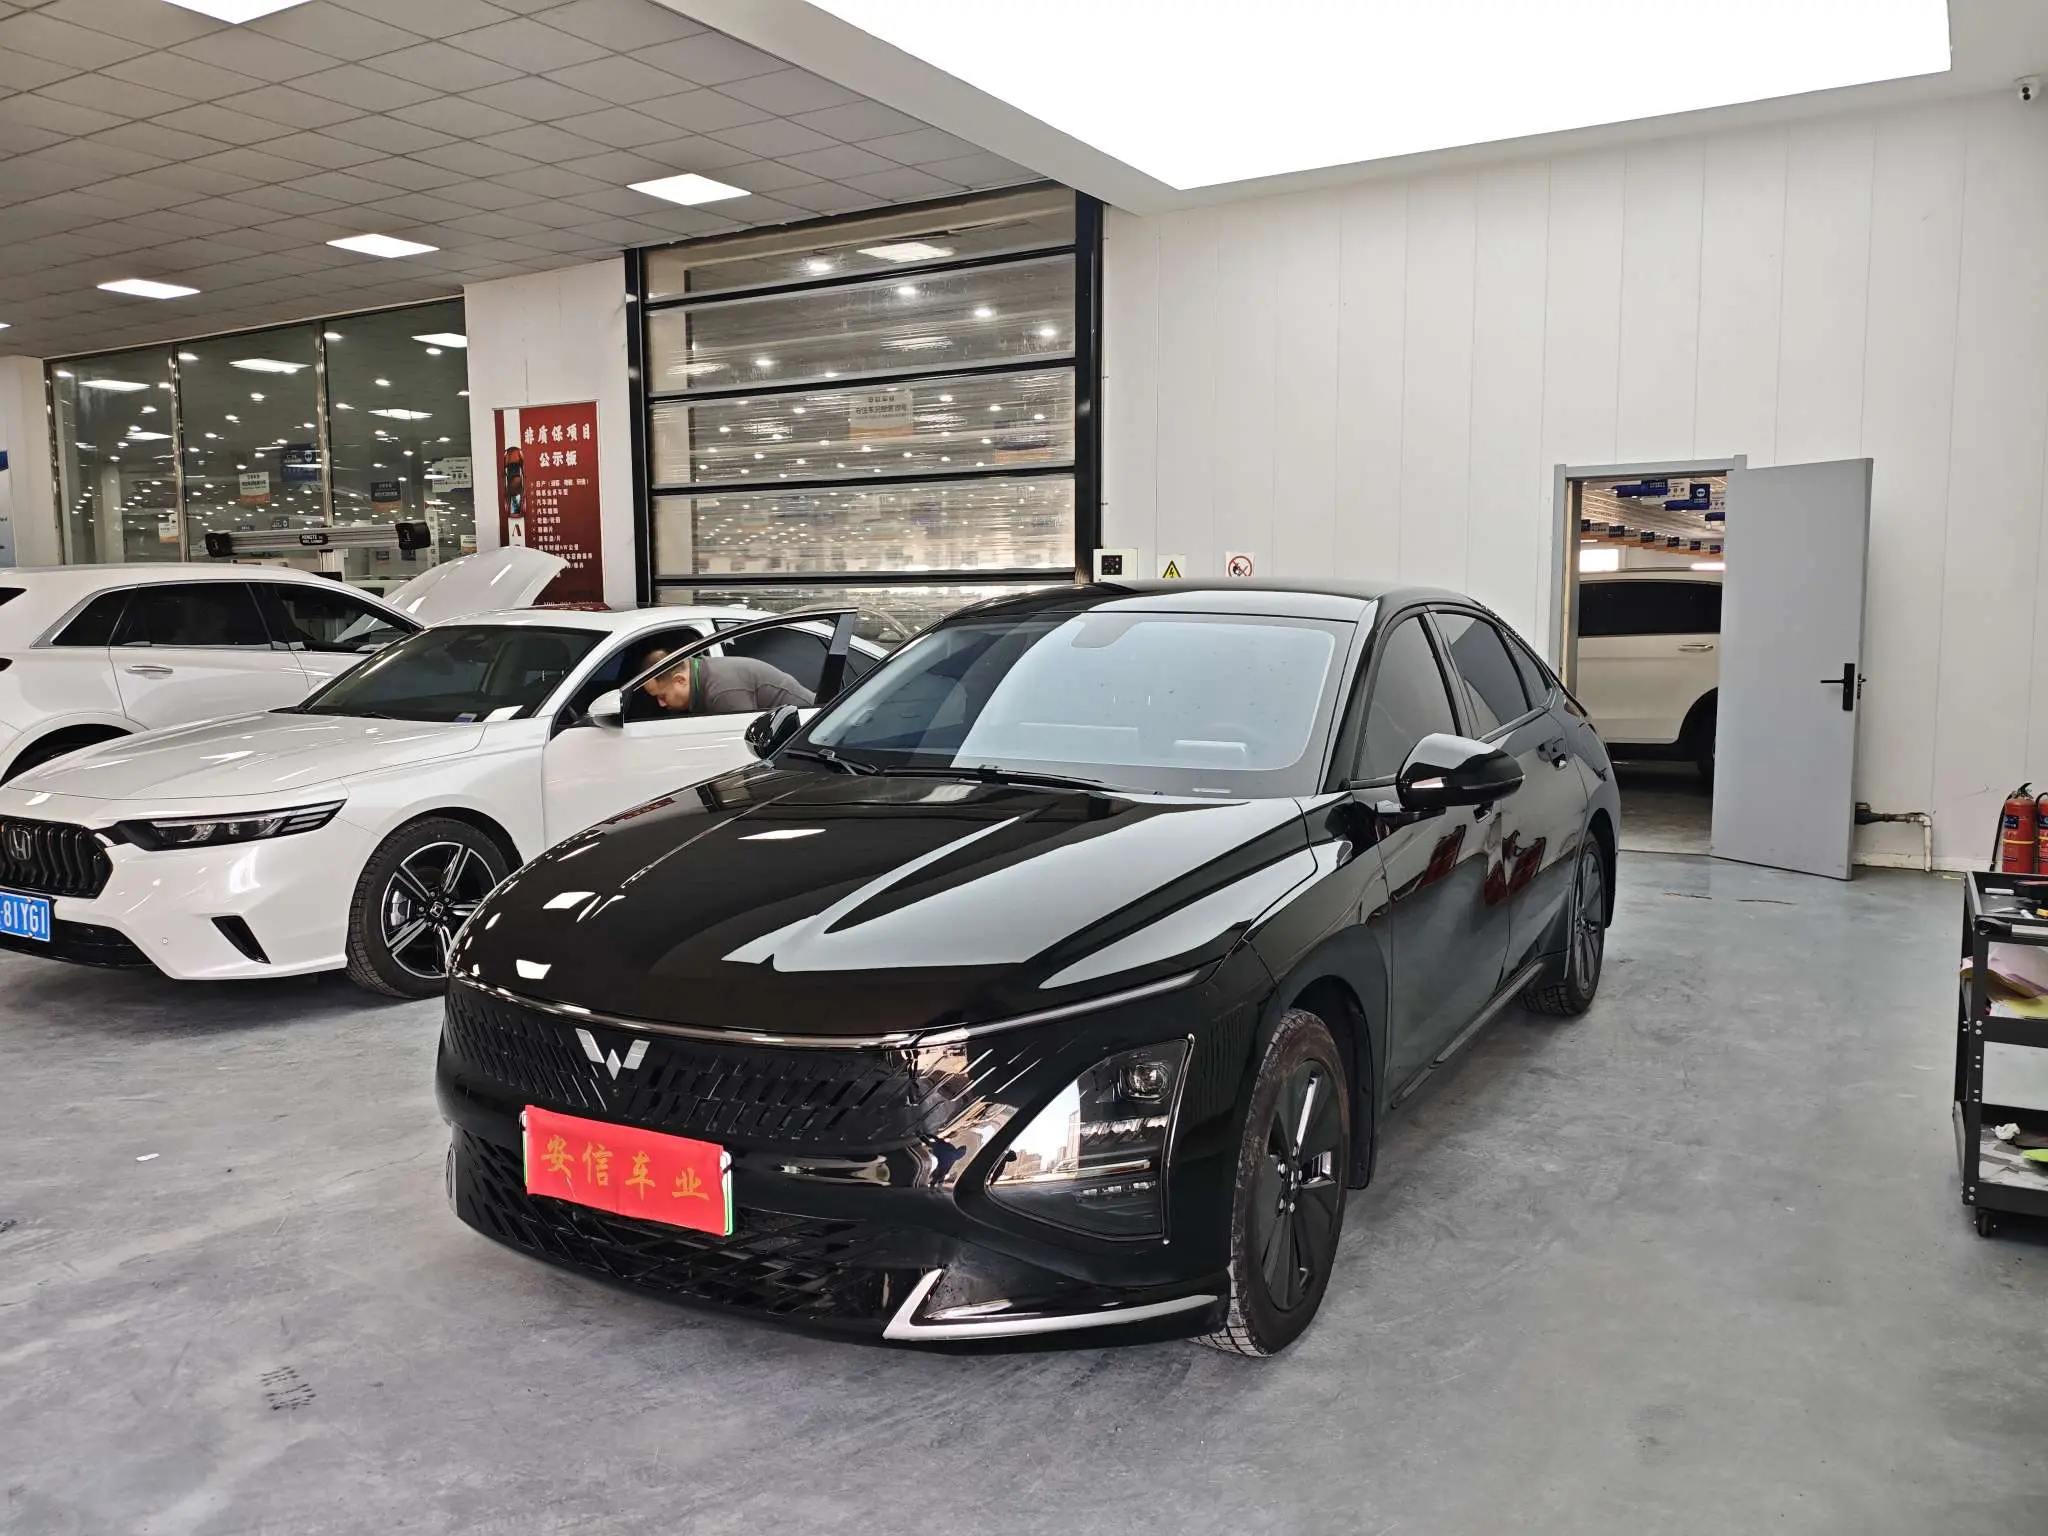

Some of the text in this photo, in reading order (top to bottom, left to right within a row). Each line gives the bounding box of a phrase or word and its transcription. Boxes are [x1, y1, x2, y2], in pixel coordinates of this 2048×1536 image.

[524, 423, 591, 445] 非质保项目
[539, 450, 577, 468] 公示板
[540, 1134, 710, 1202] 安信车业
